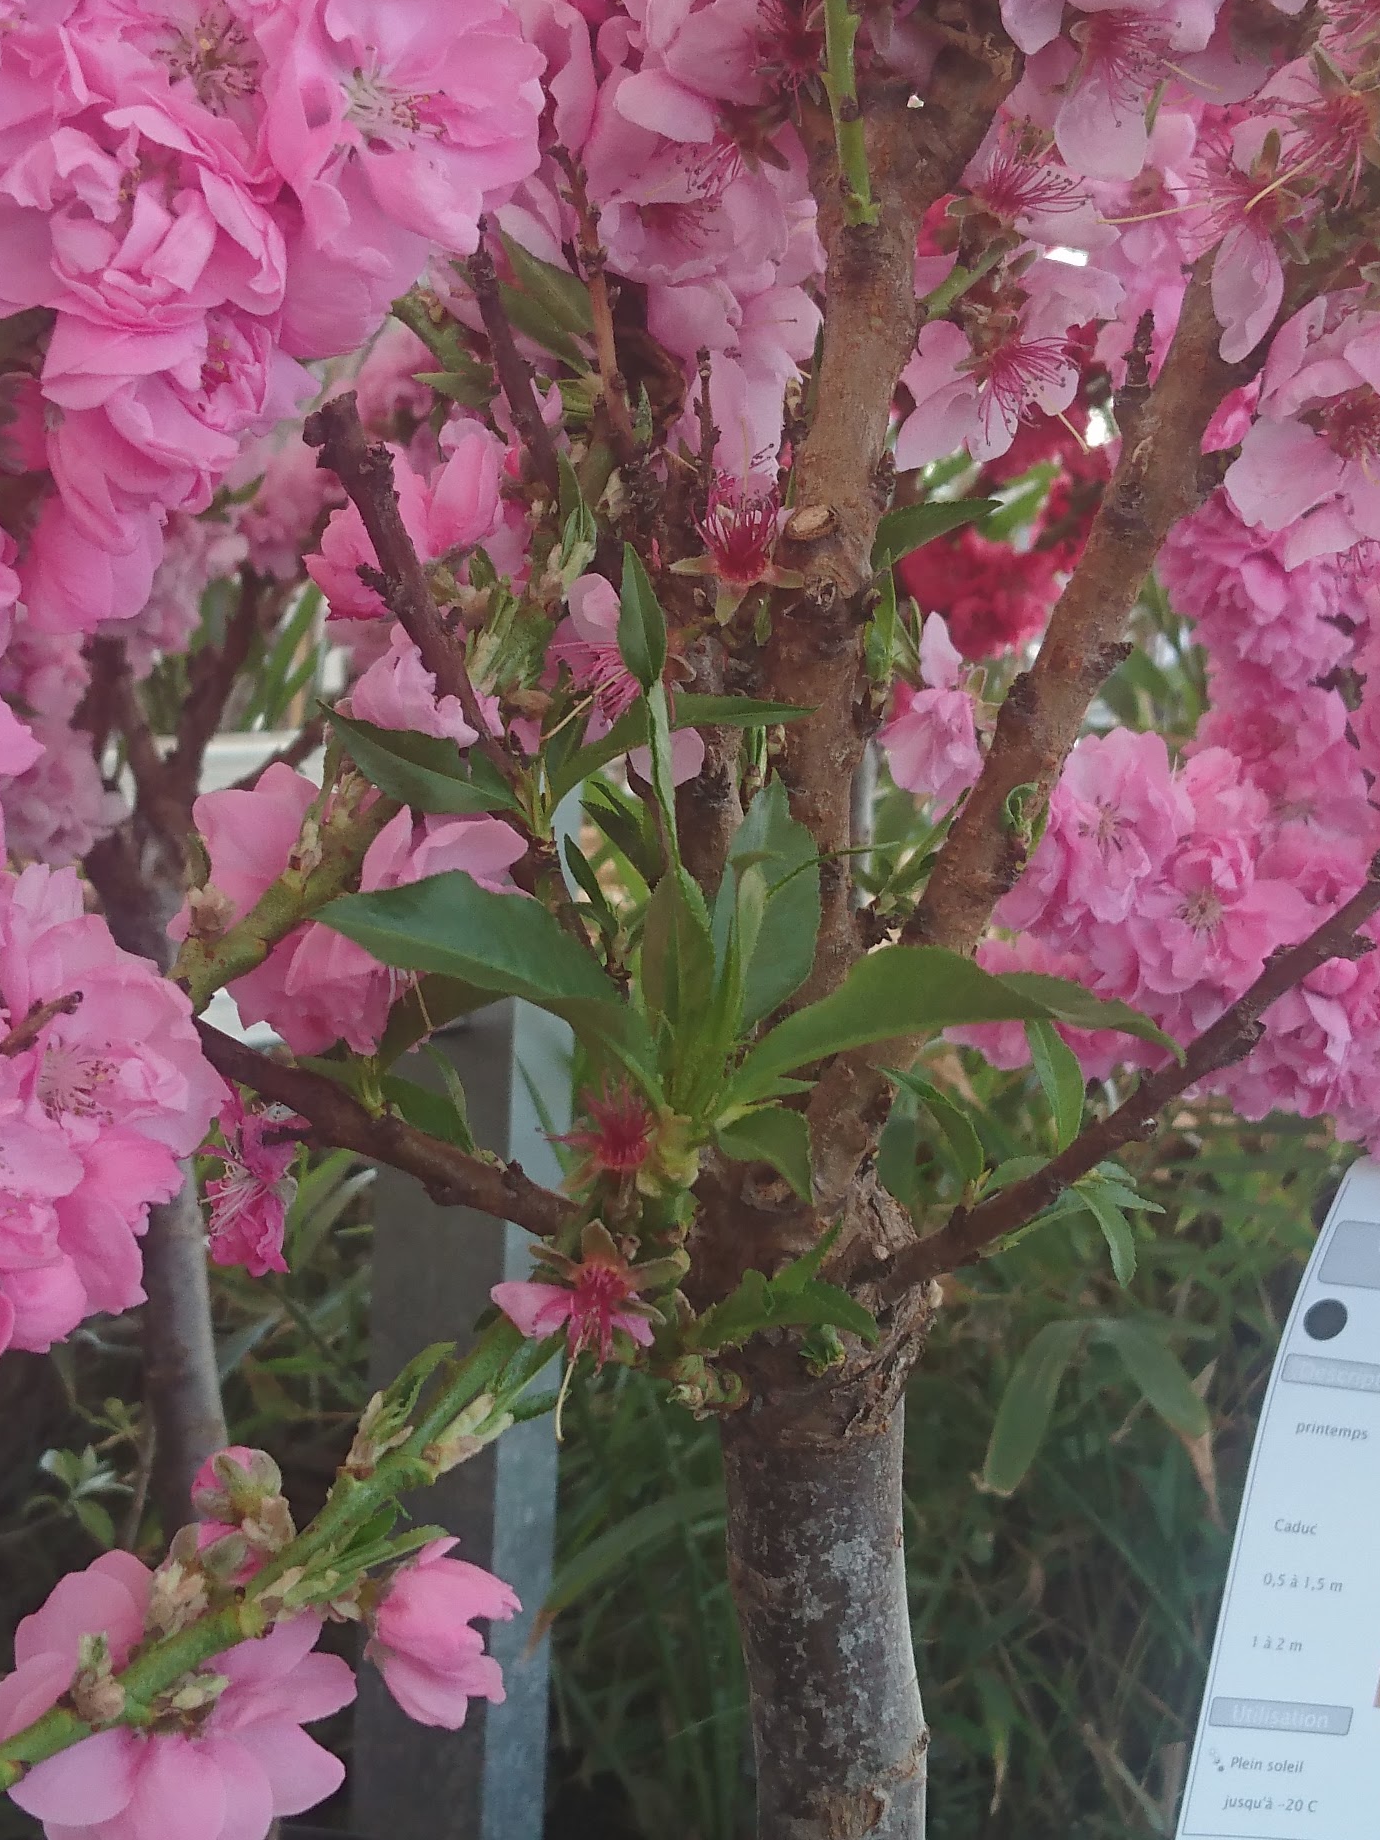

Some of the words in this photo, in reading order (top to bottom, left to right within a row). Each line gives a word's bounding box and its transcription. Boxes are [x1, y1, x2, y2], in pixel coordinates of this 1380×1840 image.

[1295, 1421, 1368, 1441] printemps
[1274, 1518, 1317, 1535] Caduc
[1263, 1572, 1286, 1587] 0,5
[1290, 1575, 1298, 1588] à
[1304, 1577, 1324, 1591] 1,5
[1330, 1582, 1343, 1592] m
[1252, 1636, 1258, 1648] 1
[1264, 1636, 1270, 1649] à
[1276, 1638, 1285, 1650] 2
[1290, 1640, 1302, 1651] m
[1232, 1704, 1330, 1728] Utilisation
[1230, 1756, 1262, 1770] Plein
[1267, 1760, 1304, 1773] soleil
[1222, 1795, 1273, 1810] jusqu'à
[1308, 1799, 1318, 1812] C
